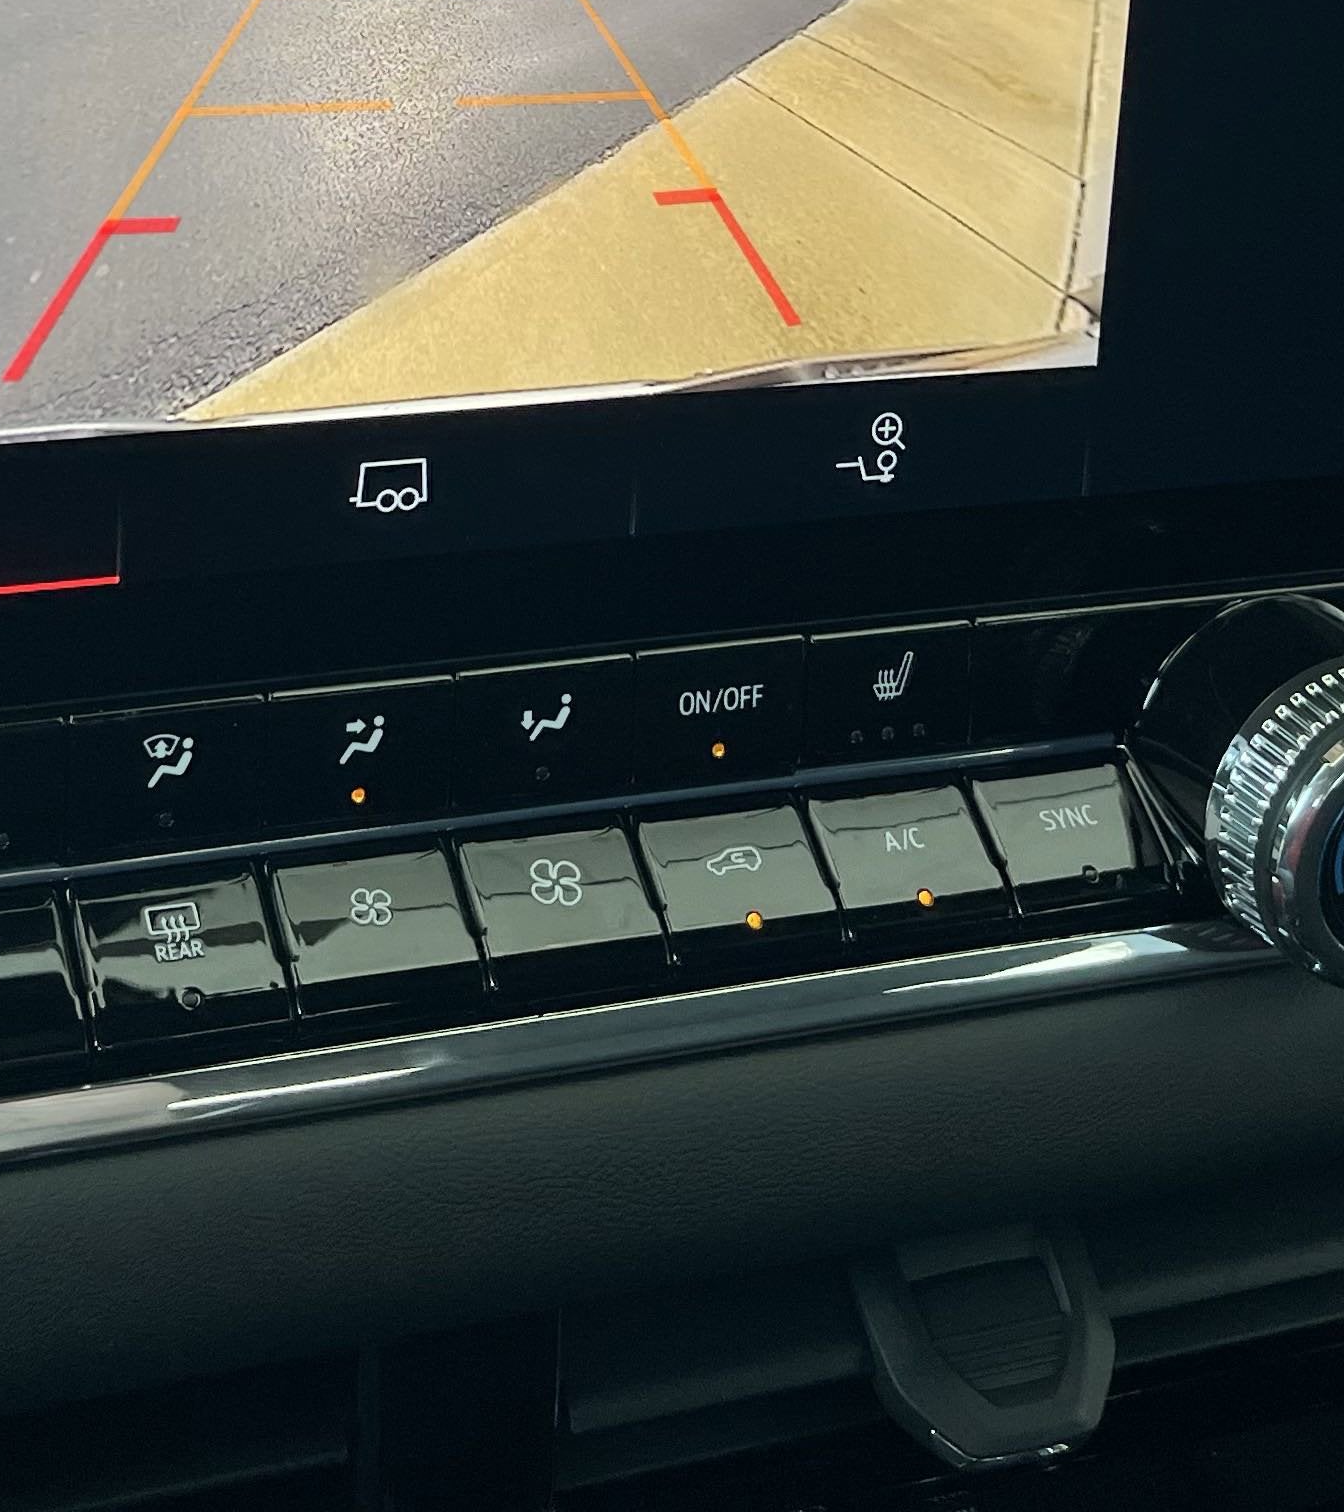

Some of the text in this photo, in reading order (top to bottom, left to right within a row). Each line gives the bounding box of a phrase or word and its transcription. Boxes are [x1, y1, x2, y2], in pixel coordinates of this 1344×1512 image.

[678, 683, 765, 717] ON/OFF
[1038, 804, 1099, 832] SYNC
[884, 826, 926, 853] A/C
[153, 937, 206, 962] REAR
